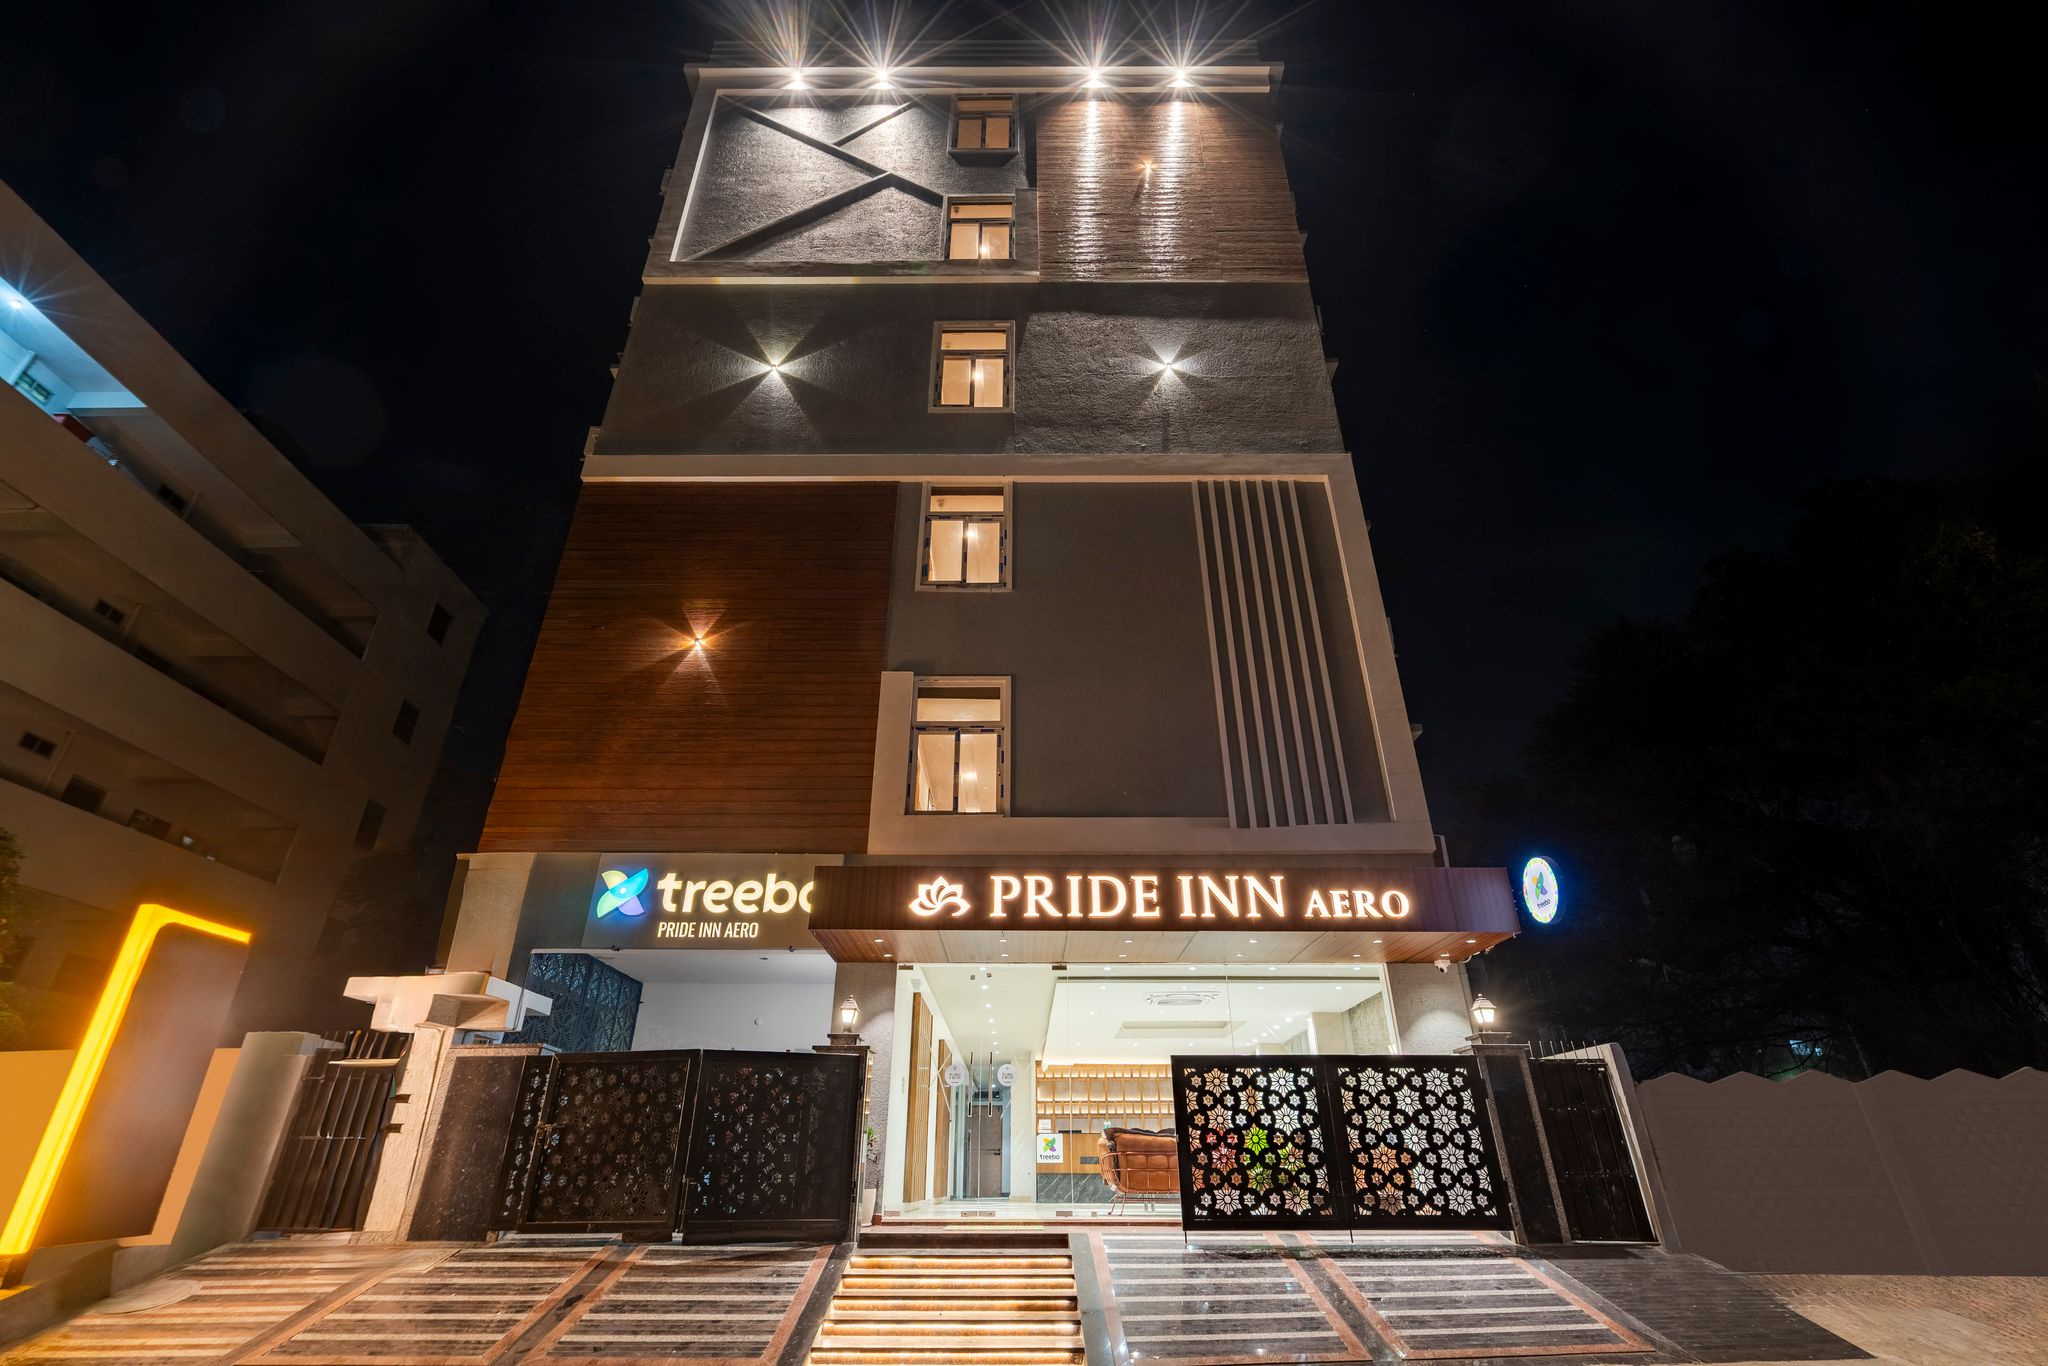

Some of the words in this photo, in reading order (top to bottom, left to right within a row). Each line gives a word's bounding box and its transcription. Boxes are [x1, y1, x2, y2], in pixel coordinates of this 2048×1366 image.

[989, 874, 1161, 919] PRIDE
[1176, 874, 1286, 919] INN
[1304, 889, 1411, 920] AERO
[657, 921, 697, 938] PRIDE
[698, 921, 722, 938] INN
[723, 921, 760, 938] AERO
[1039, 1153, 1061, 1161] treebo
